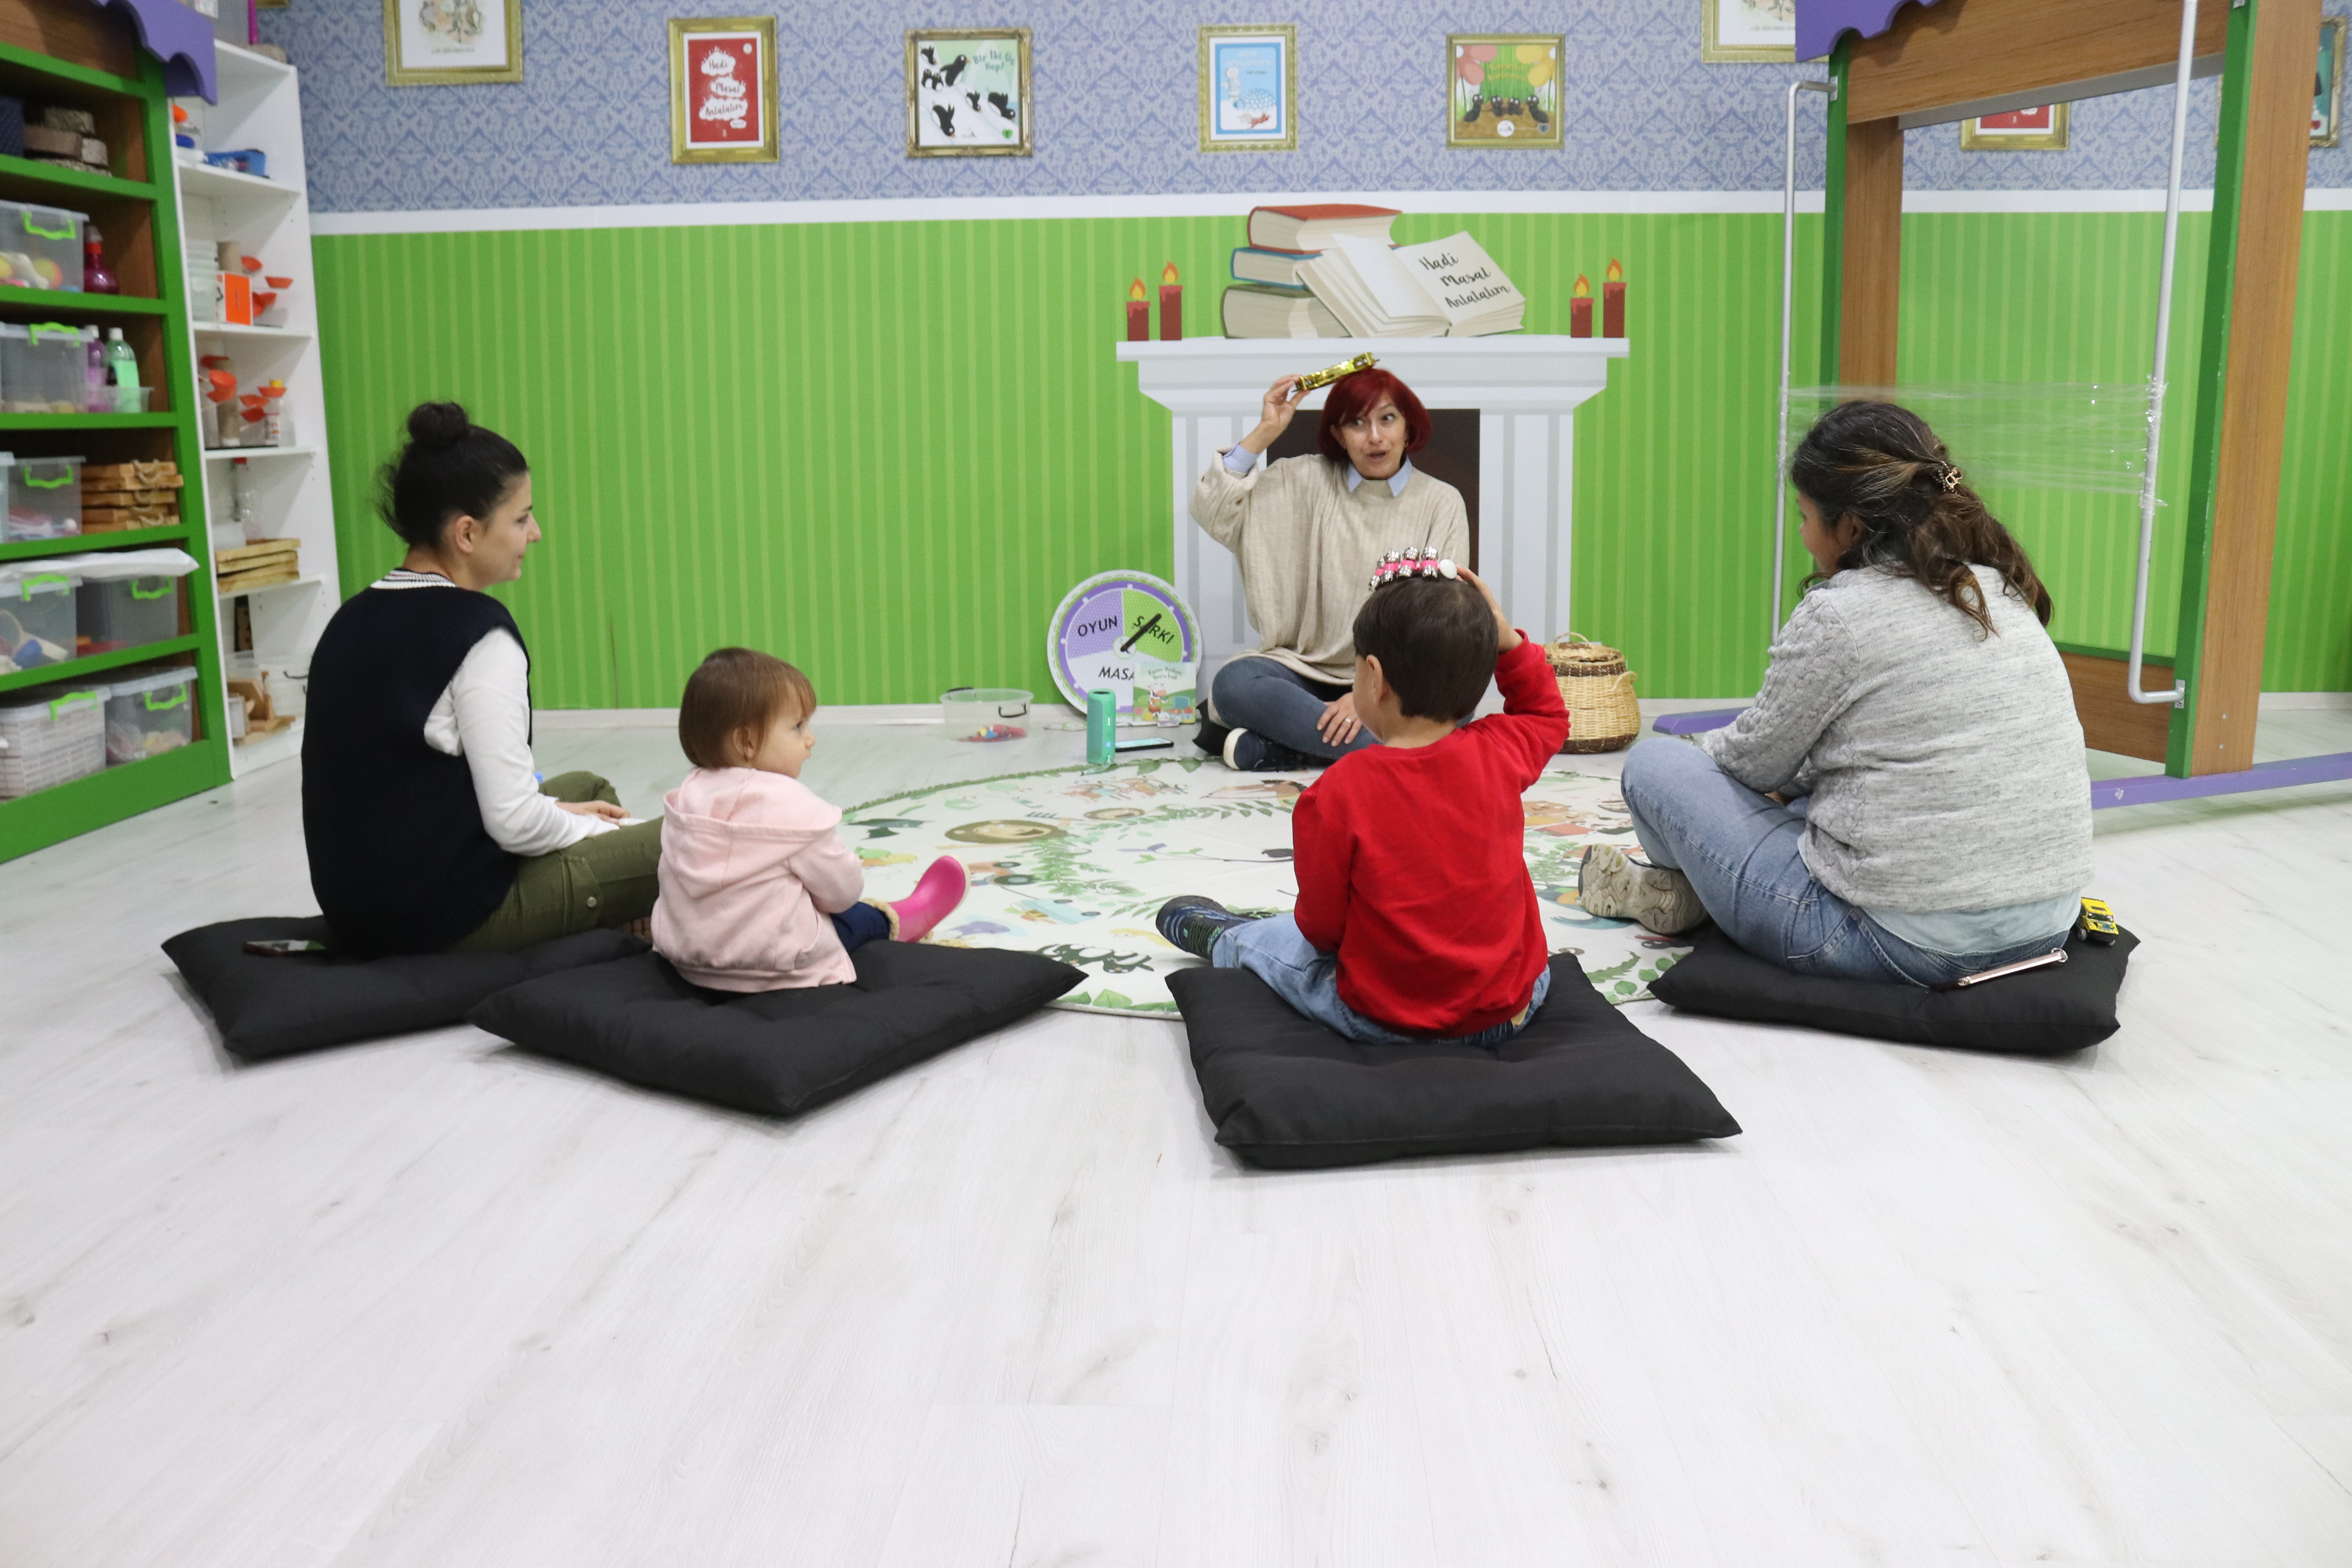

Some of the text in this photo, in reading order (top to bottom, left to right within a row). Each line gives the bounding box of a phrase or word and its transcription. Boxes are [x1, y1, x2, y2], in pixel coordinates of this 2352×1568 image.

[709, 59, 728, 70] Hadi
[715, 82, 740, 94] Masal
[1418, 252, 1458, 270] Hadi
[1439, 267, 1491, 287] Masal
[1078, 615, 1117, 637] OYUN
[1132, 615, 1174, 644] ŞRKI
